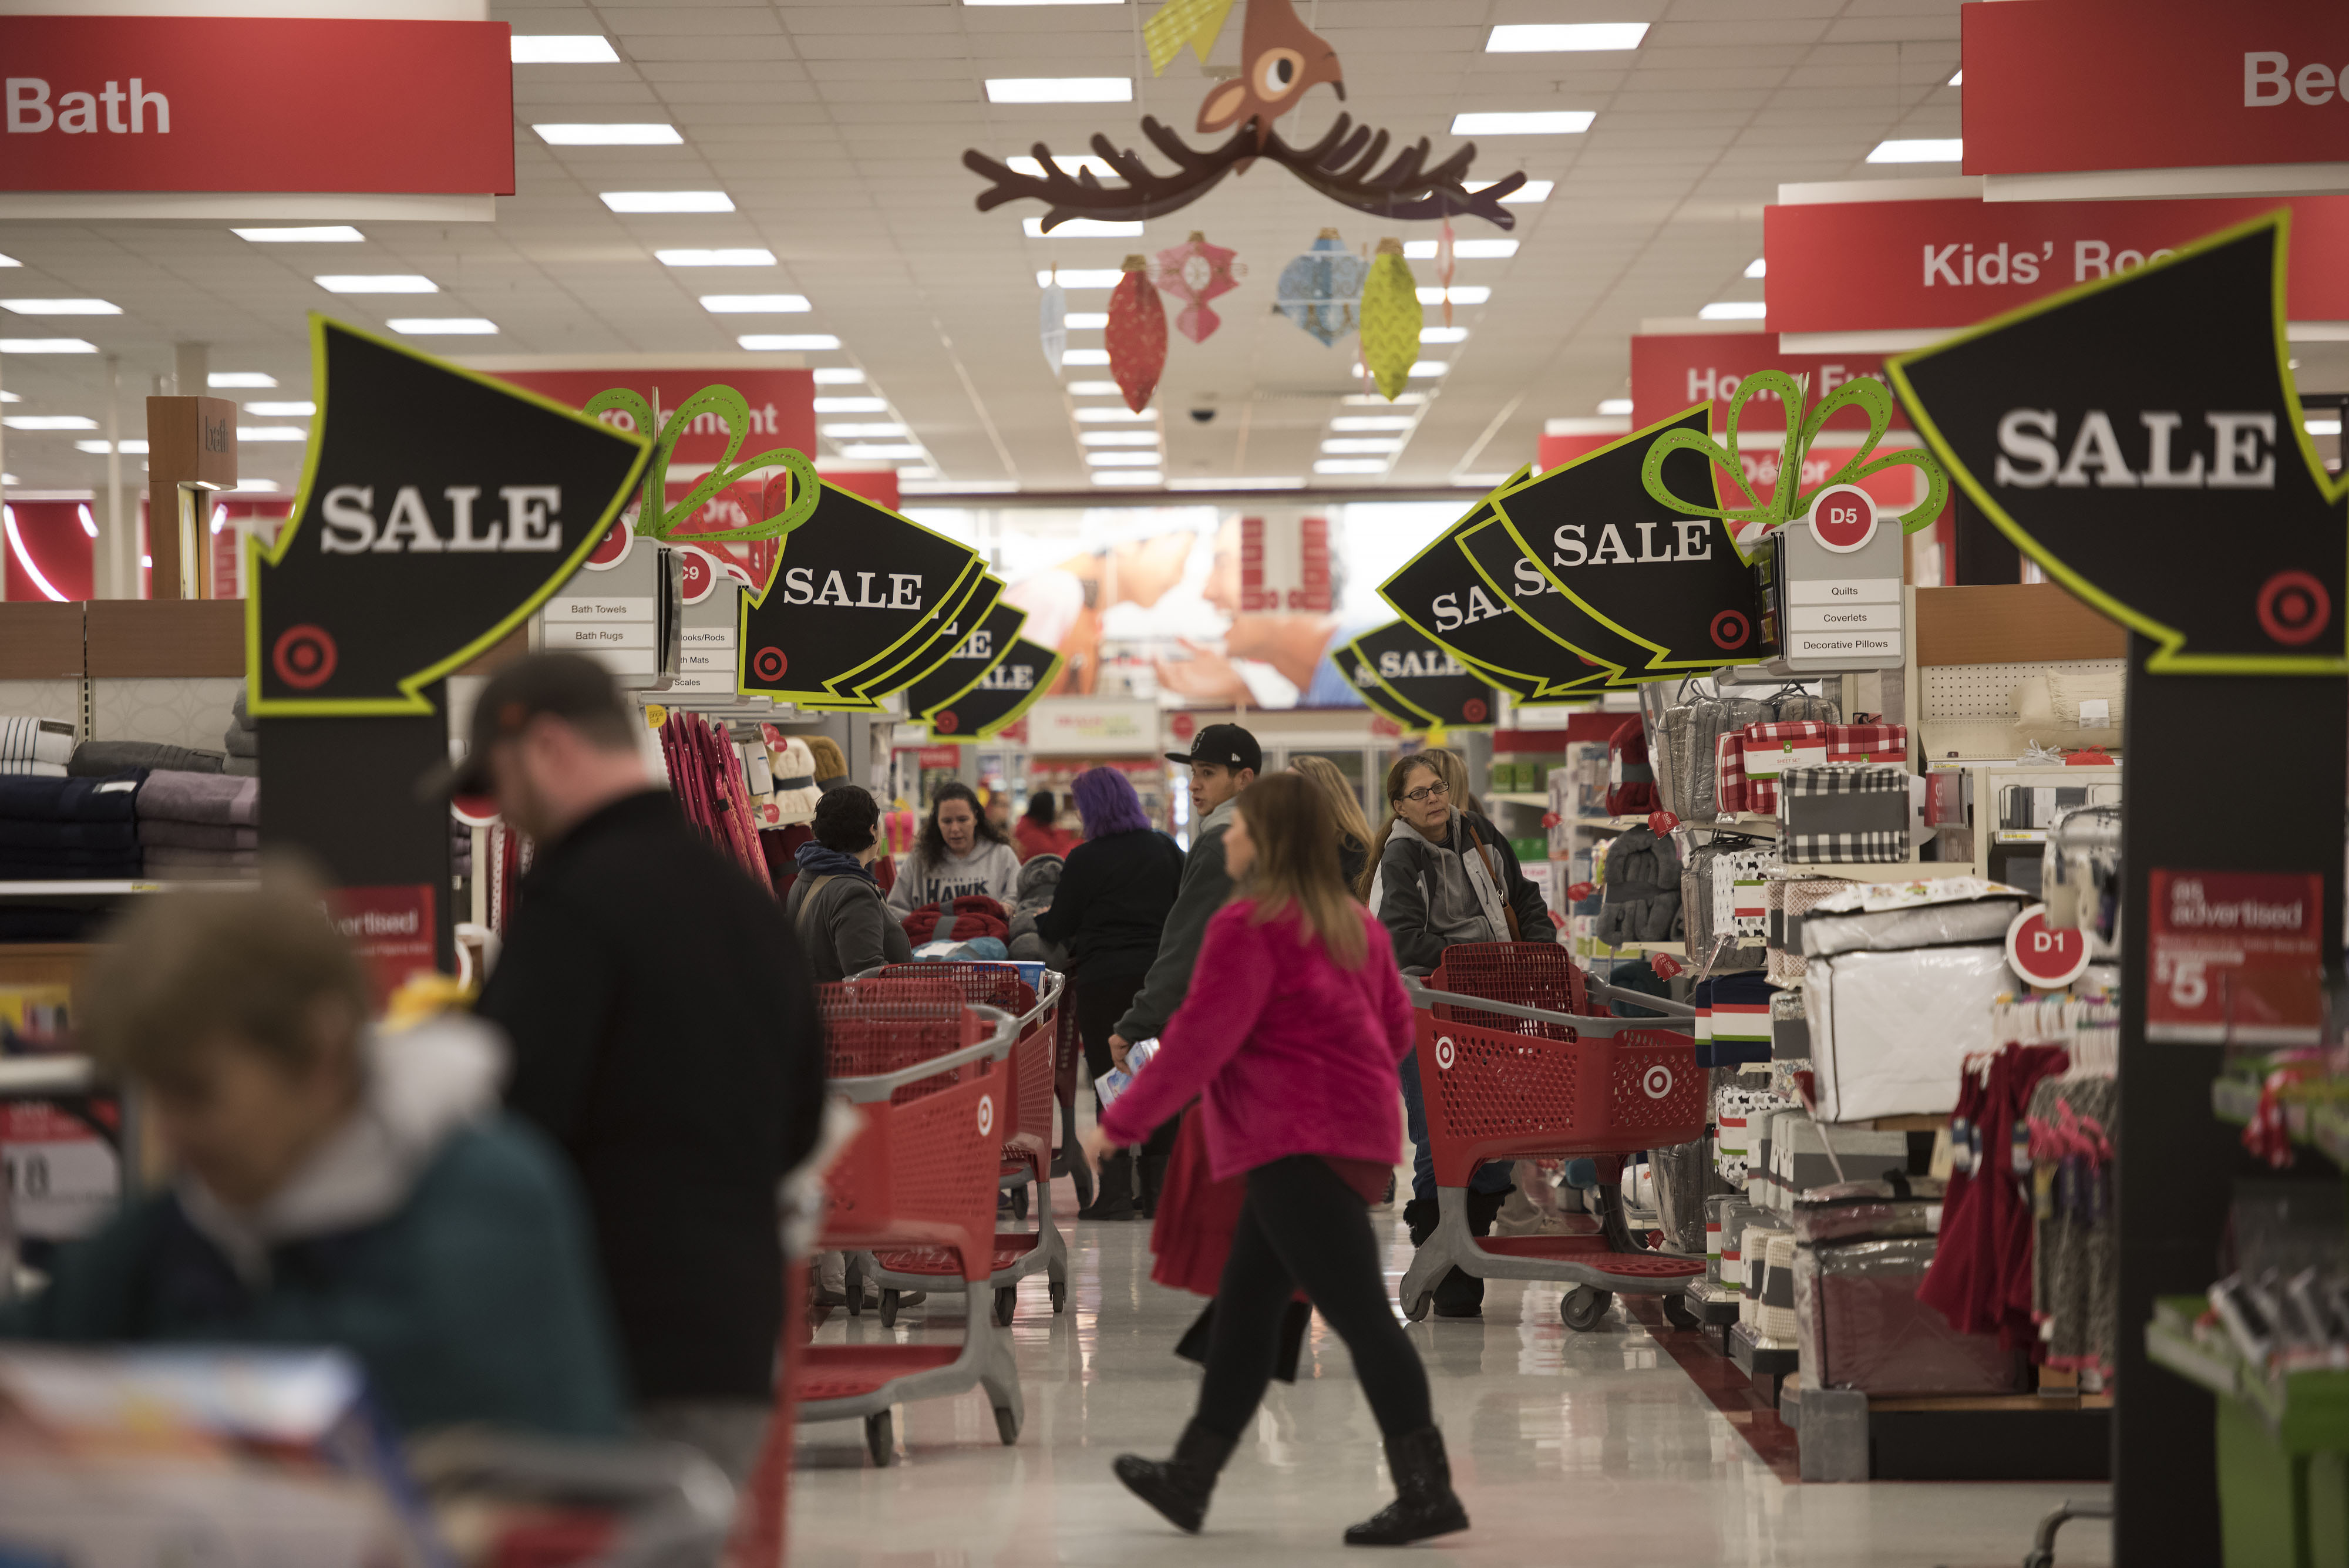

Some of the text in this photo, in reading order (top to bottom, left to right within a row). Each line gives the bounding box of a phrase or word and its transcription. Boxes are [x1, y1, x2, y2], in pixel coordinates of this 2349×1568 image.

[5, 77, 170, 134] Bath
[1995, 409, 2276, 489] SALE
[321, 484, 562, 554] SALE
[1830, 507, 1858, 524] D5
[1553, 520, 1712, 567] SALE
[783, 567, 923, 610] SALE
[1831, 587, 1859, 596] Quilts
[571, 604, 627, 614] Bath Towels
[1431, 585, 1514, 633] SA
[1823, 613, 1867, 623] Coverlets
[575, 631, 624, 642] Bath Rugs
[1803, 640, 1889, 650] Decorative Pillows
[674, 678, 701, 687] Scales
[1664, 812, 1672, 825] sale
[926, 879, 990, 905] HAWK
[320, 904, 419, 936] vertised
[2170, 899, 2303, 929] advertised
[2032, 931, 2064, 953] D1
[1665, 961, 1675, 973] sale
